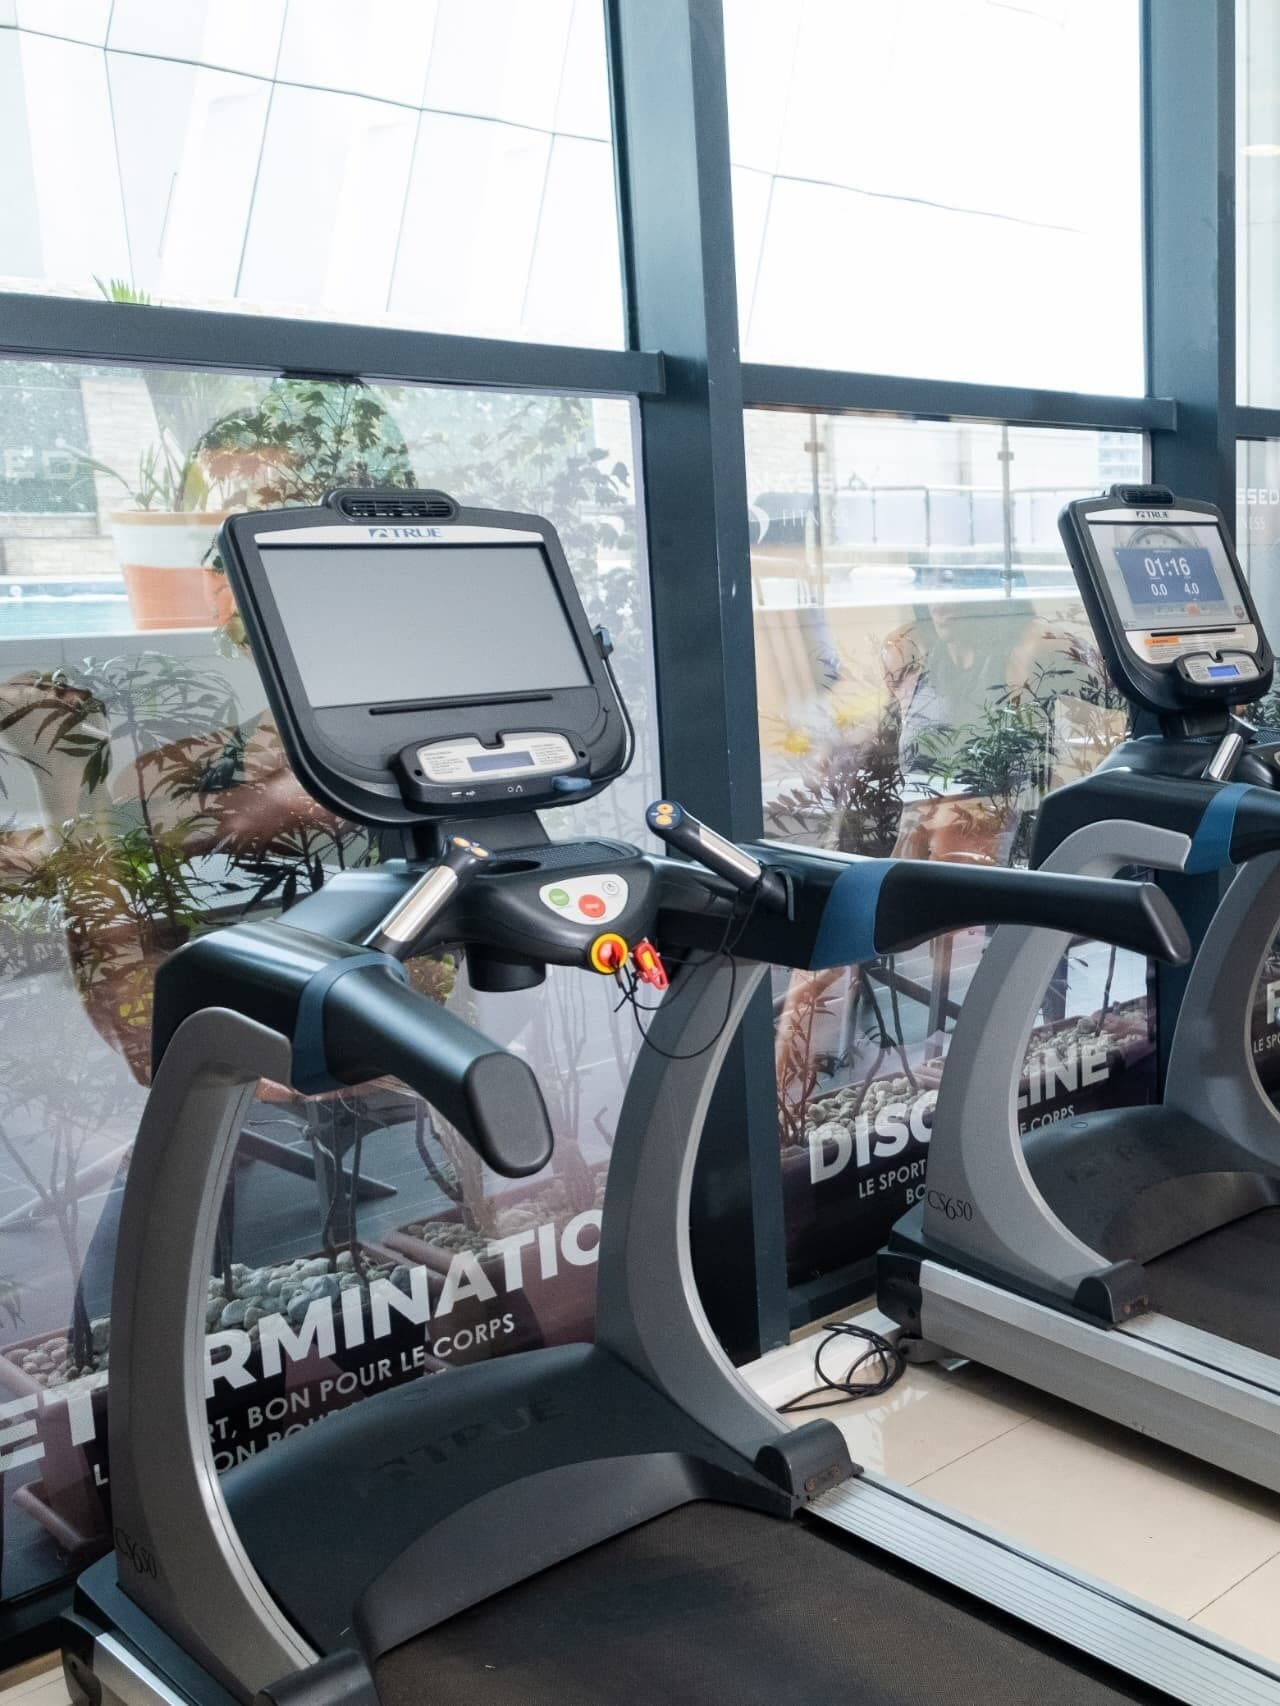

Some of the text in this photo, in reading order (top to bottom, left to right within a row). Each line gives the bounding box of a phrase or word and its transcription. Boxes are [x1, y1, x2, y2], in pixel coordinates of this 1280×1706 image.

[387, 527, 444, 538] TRUE
[1144, 556, 1191, 577] 01:16
[1150, 582, 1200, 596] 0.0 4.0
[859, 1177, 875, 1199] LE
[906, 1183, 926, 1205] BO
[927, 1189, 973, 1221] CS650
[248, 1391, 310, 1429] BON
[320, 1356, 392, 1401] POUR
[400, 1344, 425, 1373] LE
[432, 1312, 515, 1359] CORPS
[214, 1440, 256, 1474] ON
